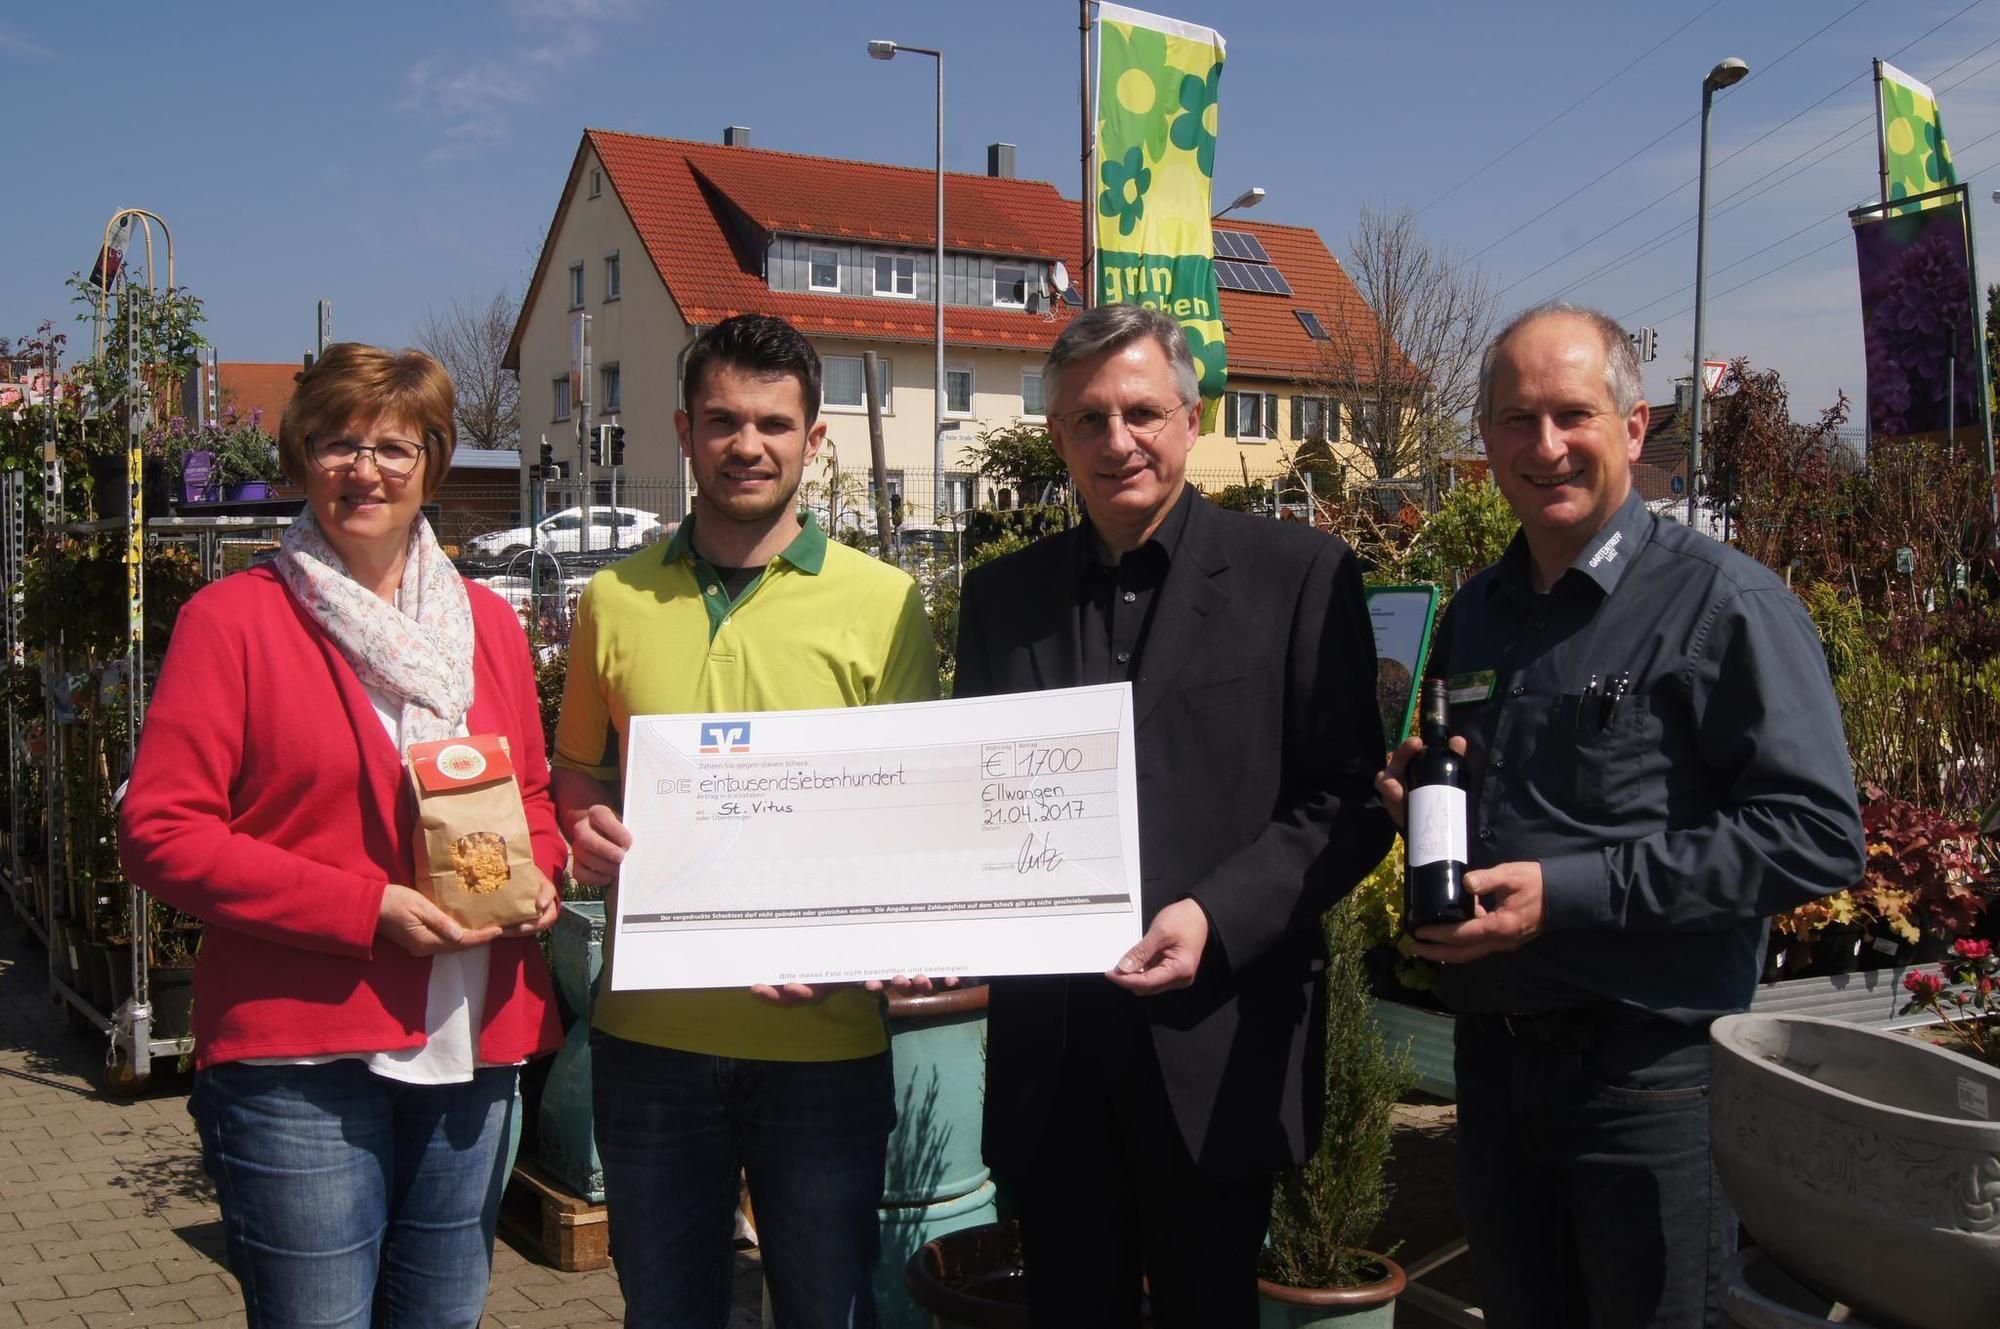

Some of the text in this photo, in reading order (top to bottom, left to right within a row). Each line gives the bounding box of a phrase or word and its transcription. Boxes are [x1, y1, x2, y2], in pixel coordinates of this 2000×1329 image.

[1588, 530, 1623, 568] GARTENTREFF
[656, 778, 692, 795] DE
[699, 760, 905, 793] eintausendsiebenhundert
[981, 782, 1065, 807] Ellwangen
[717, 799, 793, 816] St. Vitus
[984, 800, 1085, 825] 21.04.2017
[758, 911, 773, 919] nicht
[927, 903, 966, 911] Zahlungsfrist
[1015, 900, 1026, 908] gilt
